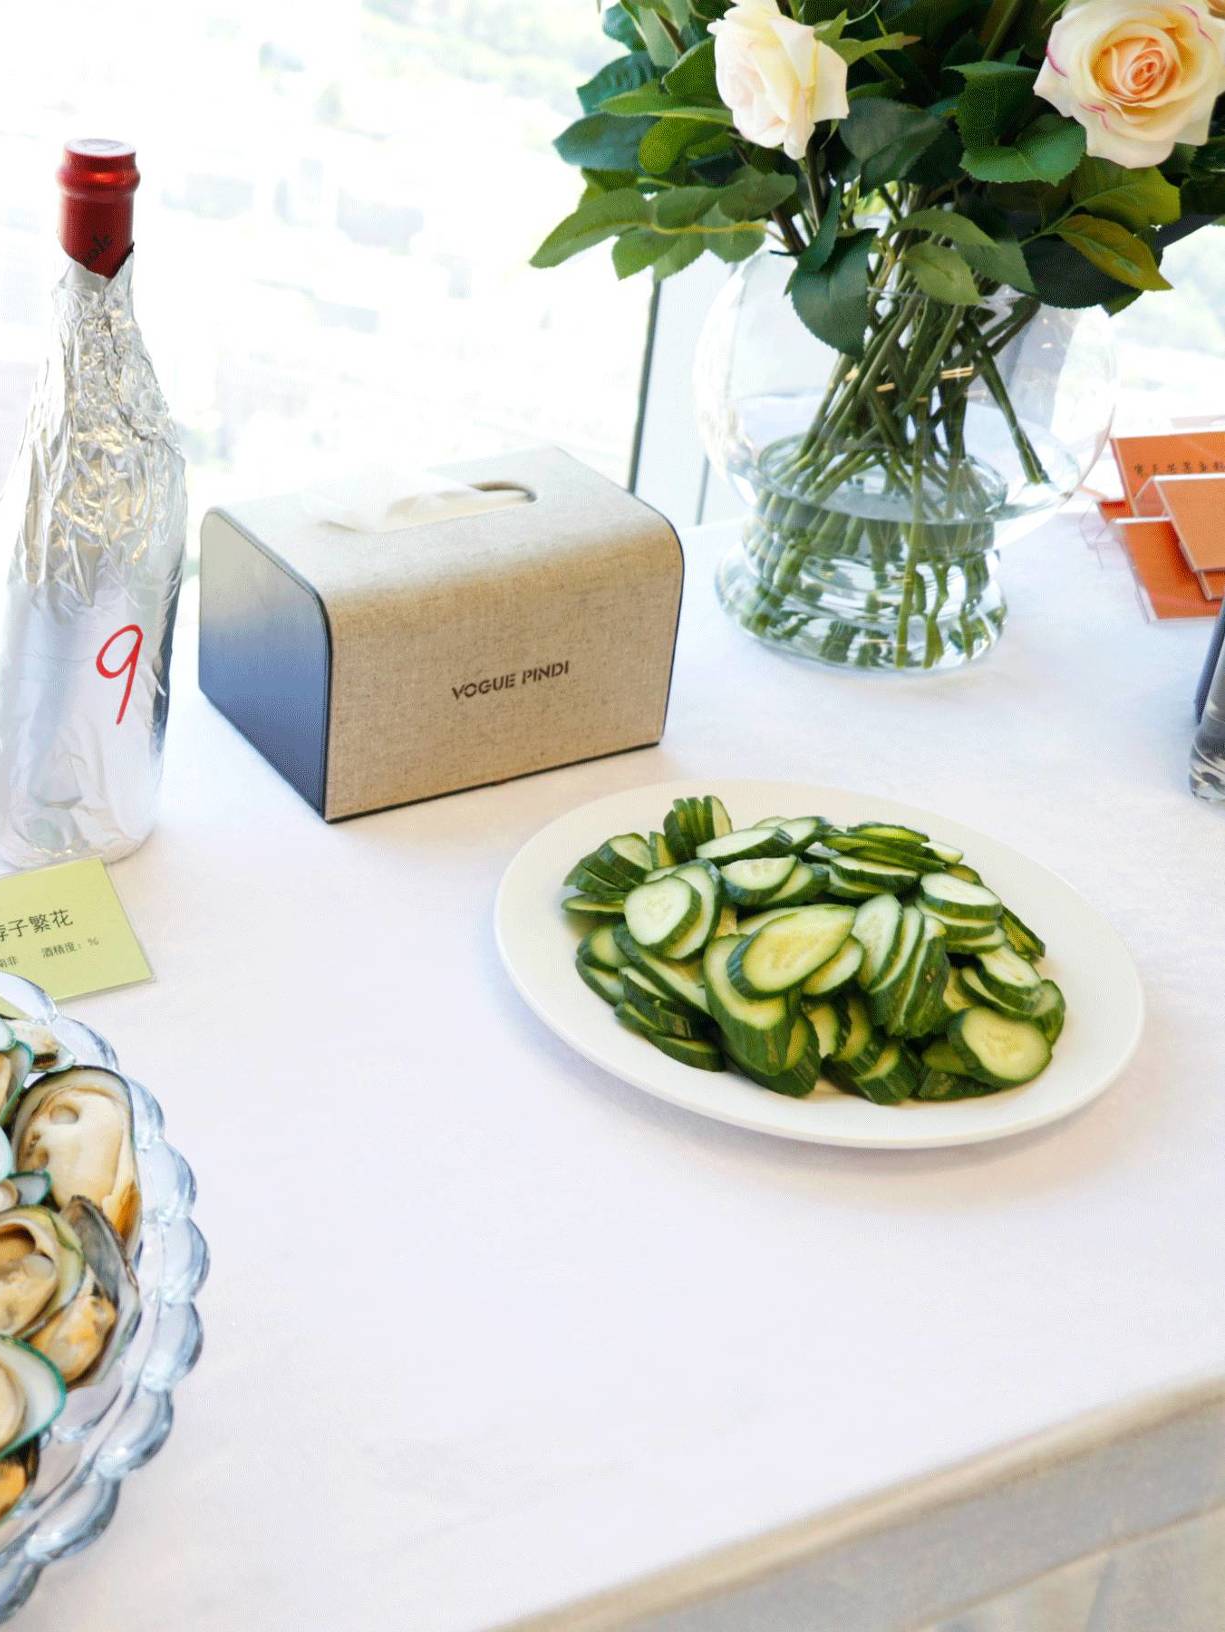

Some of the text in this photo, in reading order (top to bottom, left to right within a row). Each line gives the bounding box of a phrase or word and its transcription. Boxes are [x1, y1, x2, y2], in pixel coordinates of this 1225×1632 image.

[96, 624, 143, 724] 9
[451, 660, 570, 701] VOGUE PINDI
